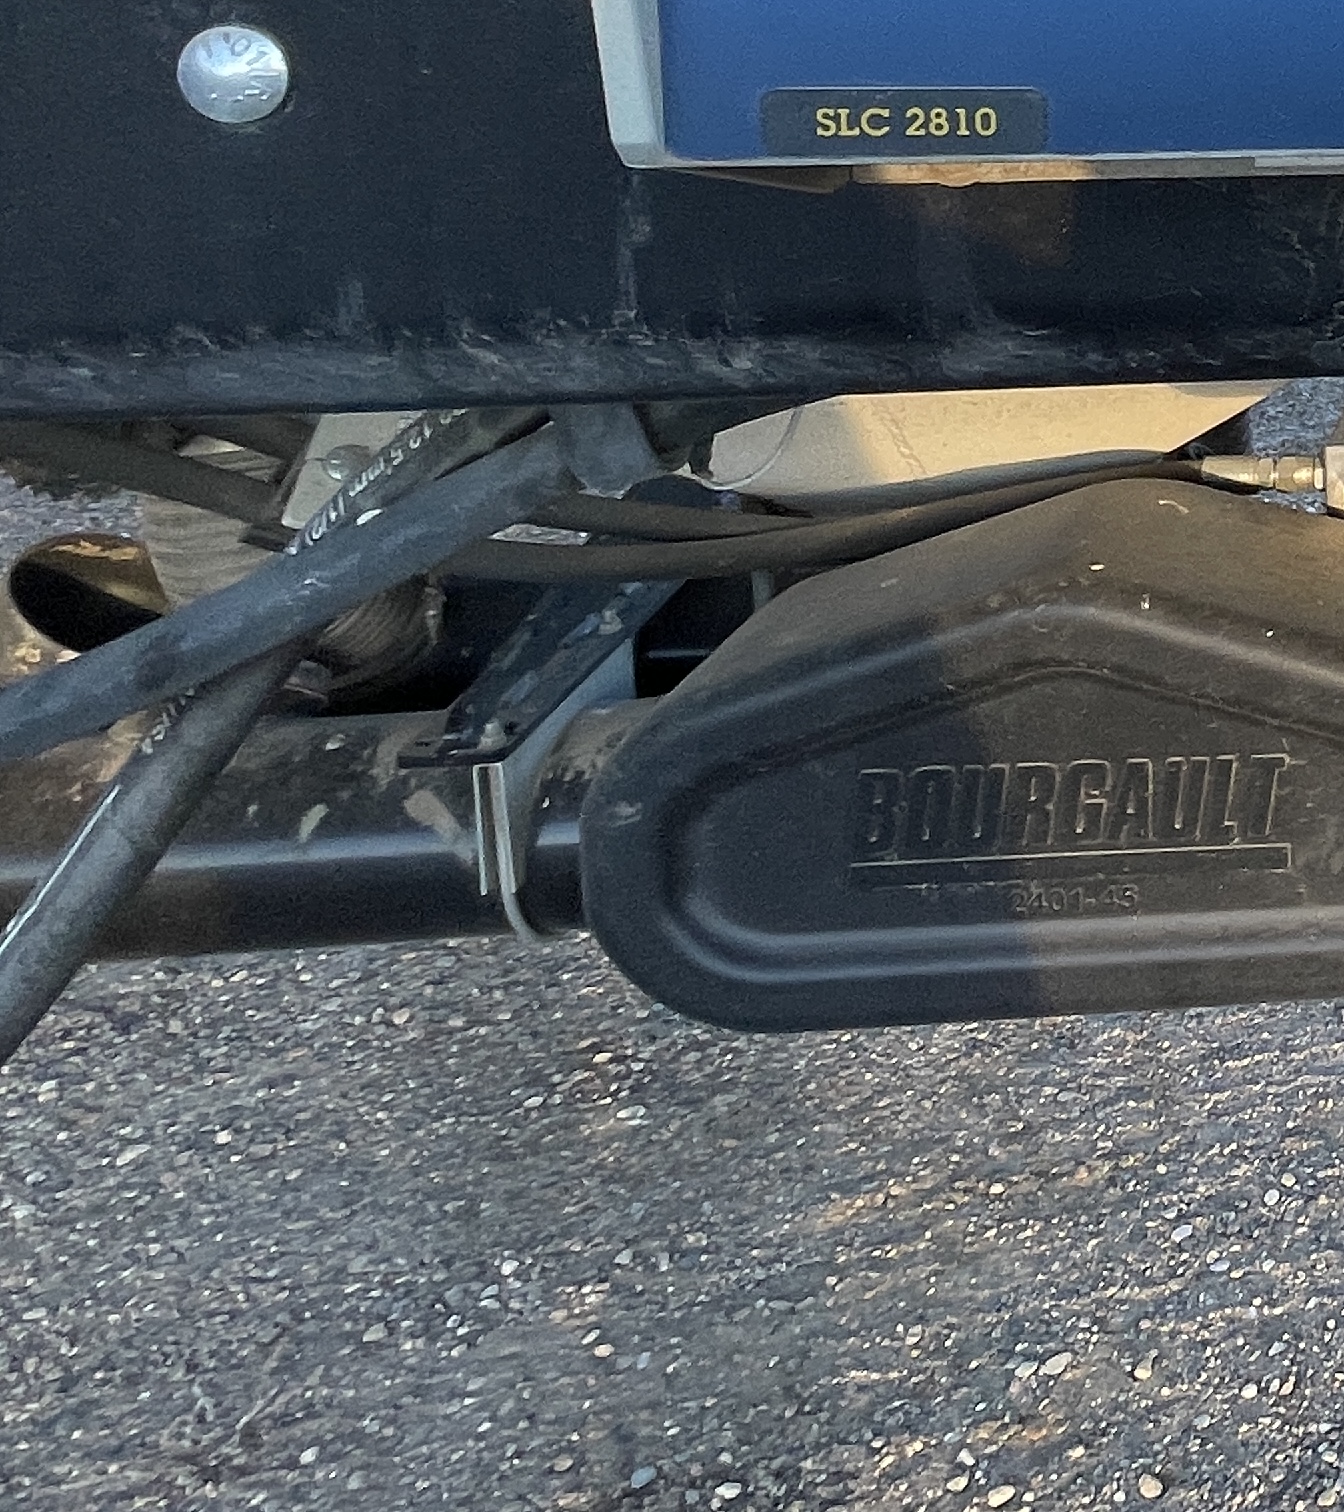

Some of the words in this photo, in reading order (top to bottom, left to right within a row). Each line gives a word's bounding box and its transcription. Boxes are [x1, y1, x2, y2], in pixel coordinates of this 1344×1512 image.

[815, 108, 890, 137] SLC
[905, 107, 998, 137] 2810
[854, 754, 1291, 861] BOURGAULT
